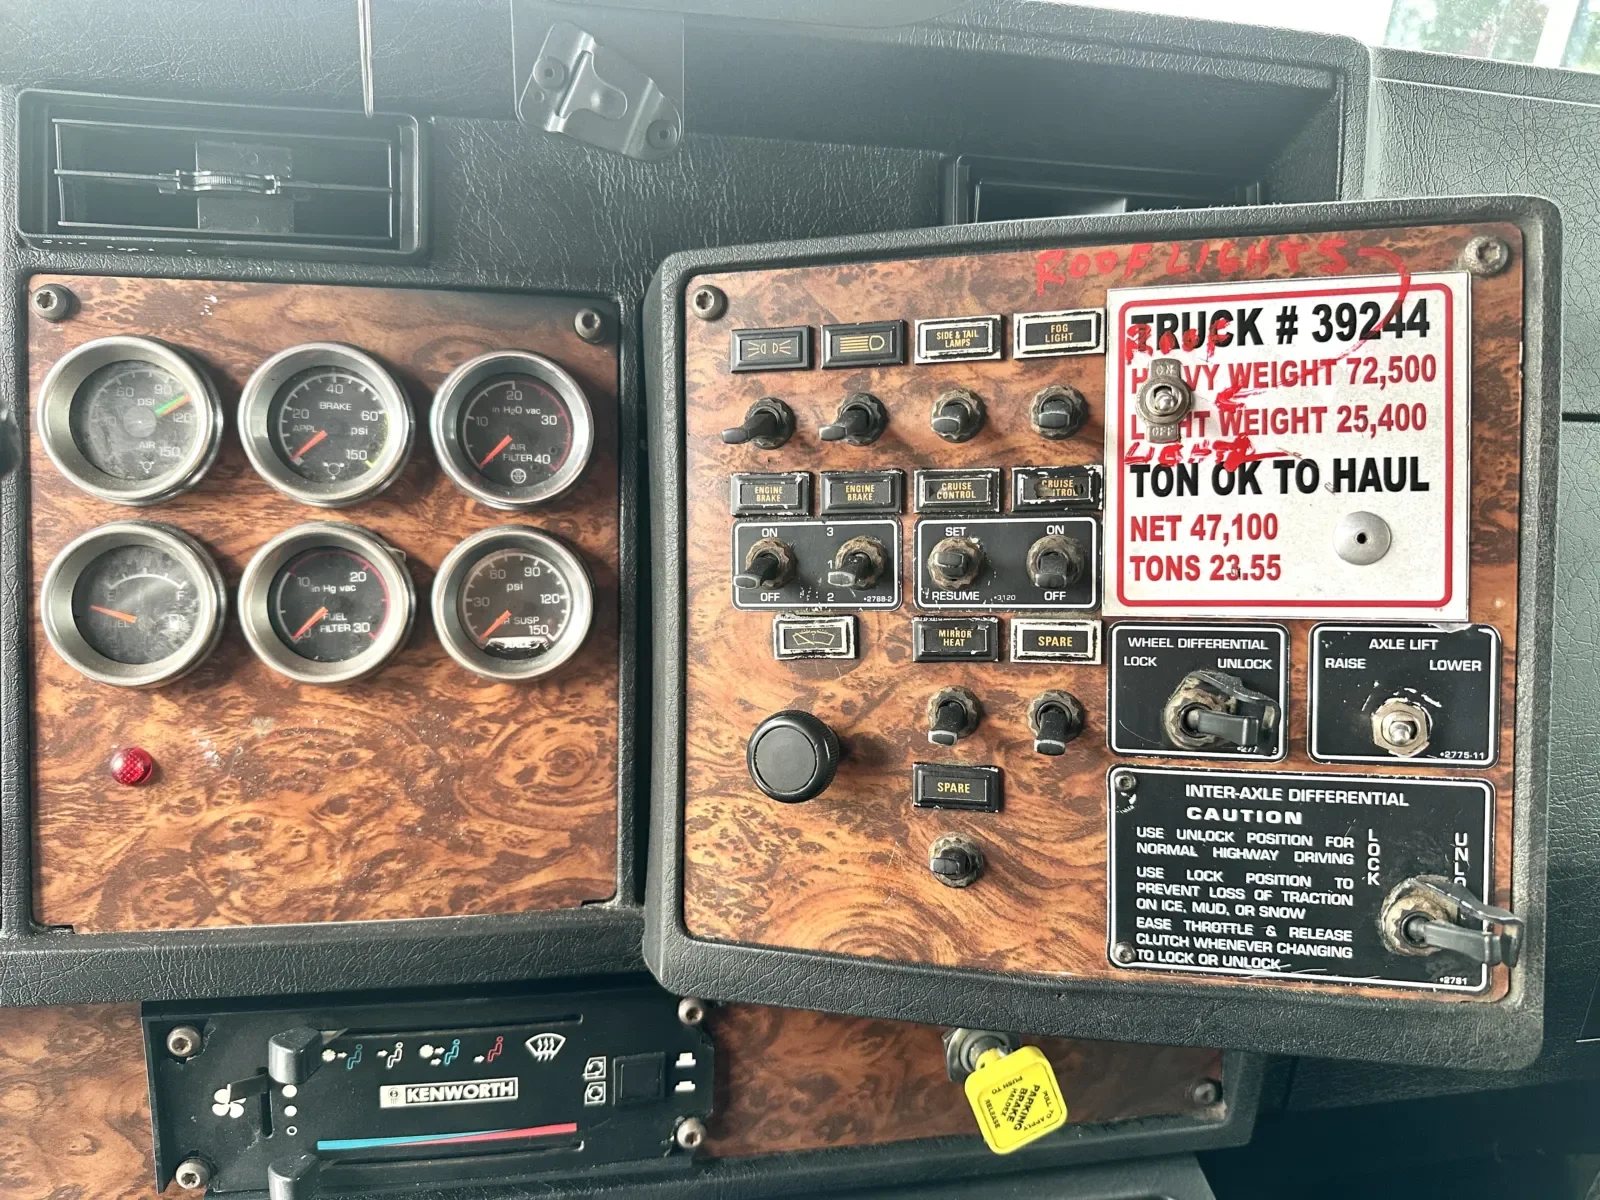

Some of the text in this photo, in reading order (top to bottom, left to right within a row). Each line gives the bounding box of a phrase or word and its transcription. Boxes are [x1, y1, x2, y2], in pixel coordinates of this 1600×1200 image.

[1035, 239, 1350, 296] ROOF LIGHTS
[1050, 324, 1068, 332] FOG
[1131, 298, 1430, 351] TRUCK # 39244
[936, 329, 979, 340] SIDE & TAIL
[1045, 332, 1074, 343] LIGHT
[944, 338, 971, 348] LAMPS
[1131, 354, 1436, 395] HVY WEIGHT 72,500
[154, 384, 172, 395] 90
[326, 384, 344, 394] 40
[506, 390, 522, 400] 20
[320, 402, 352, 410] BRAKE
[172, 412, 193, 423] 120
[292, 409, 310, 419] 20
[361, 411, 378, 422] 60
[476, 416, 488, 426] 10
[541, 415, 558, 426] 30
[1131, 402, 1427, 440] LHT WEIGHT 25,400
[292, 424, 316, 432] APPL
[351, 426, 368, 436] psi
[1152, 426, 1175, 437] OFF
[140, 441, 156, 449] AIR
[159, 446, 180, 457] 150
[346, 450, 368, 460] 150
[503, 454, 532, 462] FILTER
[534, 454, 550, 464] 40
[1130, 456, 1430, 498] TON OK TO HAUL
[845, 484, 874, 492] ENGINE
[942, 482, 972, 490] CRUISE
[1042, 480, 1074, 488] CRUISE
[754, 486, 783, 494] ENGINE
[936, 490, 976, 500] CONTROL
[756, 494, 781, 502] BRAKE
[847, 493, 873, 501] BRAKE
[762, 528, 778, 538] ON
[826, 528, 834, 537] 3
[945, 527, 966, 536] SET
[1046, 525, 1064, 534] ON
[1130, 513, 1278, 547] NET 47,100
[828, 560, 832, 569] 1
[1130, 554, 1281, 582] TONS 23.55
[350, 572, 366, 582] 20
[490, 569, 506, 580] 60
[524, 566, 540, 577] 90
[298, 577, 310, 588] 10
[506, 581, 524, 592] psi
[323, 585, 336, 594] Hg
[340, 584, 356, 592] vac
[176, 590, 184, 600] F
[540, 594, 560, 604] 120
[760, 592, 780, 602] OFF
[827, 593, 834, 602] 2
[932, 592, 980, 600] RESUME
[1044, 592, 1066, 600] OFF
[474, 596, 490, 608] 30
[322, 612, 347, 620] FUEL
[514, 616, 540, 624] SUSP
[320, 624, 351, 633] FILTER
[352, 622, 370, 633] 30
[528, 625, 548, 635] 150
[938, 630, 972, 638] MIRROR
[944, 638, 964, 646] HEAT
[1038, 636, 1073, 647] SPARE
[1128, 637, 1269, 650] WHEEL DIFFERENTIAL
[1369, 638, 1440, 650] AXLE LIFT
[1124, 656, 1158, 667] LOCK
[1218, 658, 1273, 670] UNLOCK
[1324, 658, 1366, 670] RAISE
[1430, 660, 1482, 672] LOWER
[937, 782, 970, 794] SPARE
[1185, 784, 1410, 807] INTER-AXLE DIFFERENTIAL
[1186, 806, 1302, 825] CAUTION
[1136, 826, 1354, 848] USE UNLOCK POSITION FOR
[1136, 842, 1354, 866] NORMAL HIGHWAY DRIVING
[1367, 828, 1380, 886] LOCK
[1454, 832, 1469, 887] UNLO
[1136, 866, 1354, 890] USE LOCK POSITION TO
[1136, 882, 1354, 906] PREVENT LOSS OF TRACTION
[1136, 898, 1158, 911] ON
[1234, 904, 1255, 917] OR
[1258, 906, 1306, 920] SNOW
[1136, 916, 1353, 942] EASE THROTTLE & RELEASE
[1136, 933, 1353, 958] CLUTCH WHENEVER CHANGING
[1136, 949, 1281, 970] TO LOCK OR UNLOCK
[1003, 1075, 1023, 1090] PUSH
[406, 1080, 514, 1102] KENWORTH
[1001, 1088, 1018, 1116] HALDEX
[1006, 1087, 1028, 1123] BRAKE
[1013, 1084, 1040, 1131] PARKING
[984, 1099, 1000, 1129] RELEASE
[1024, 1090, 1054, 1131] PULL TO APPLY
